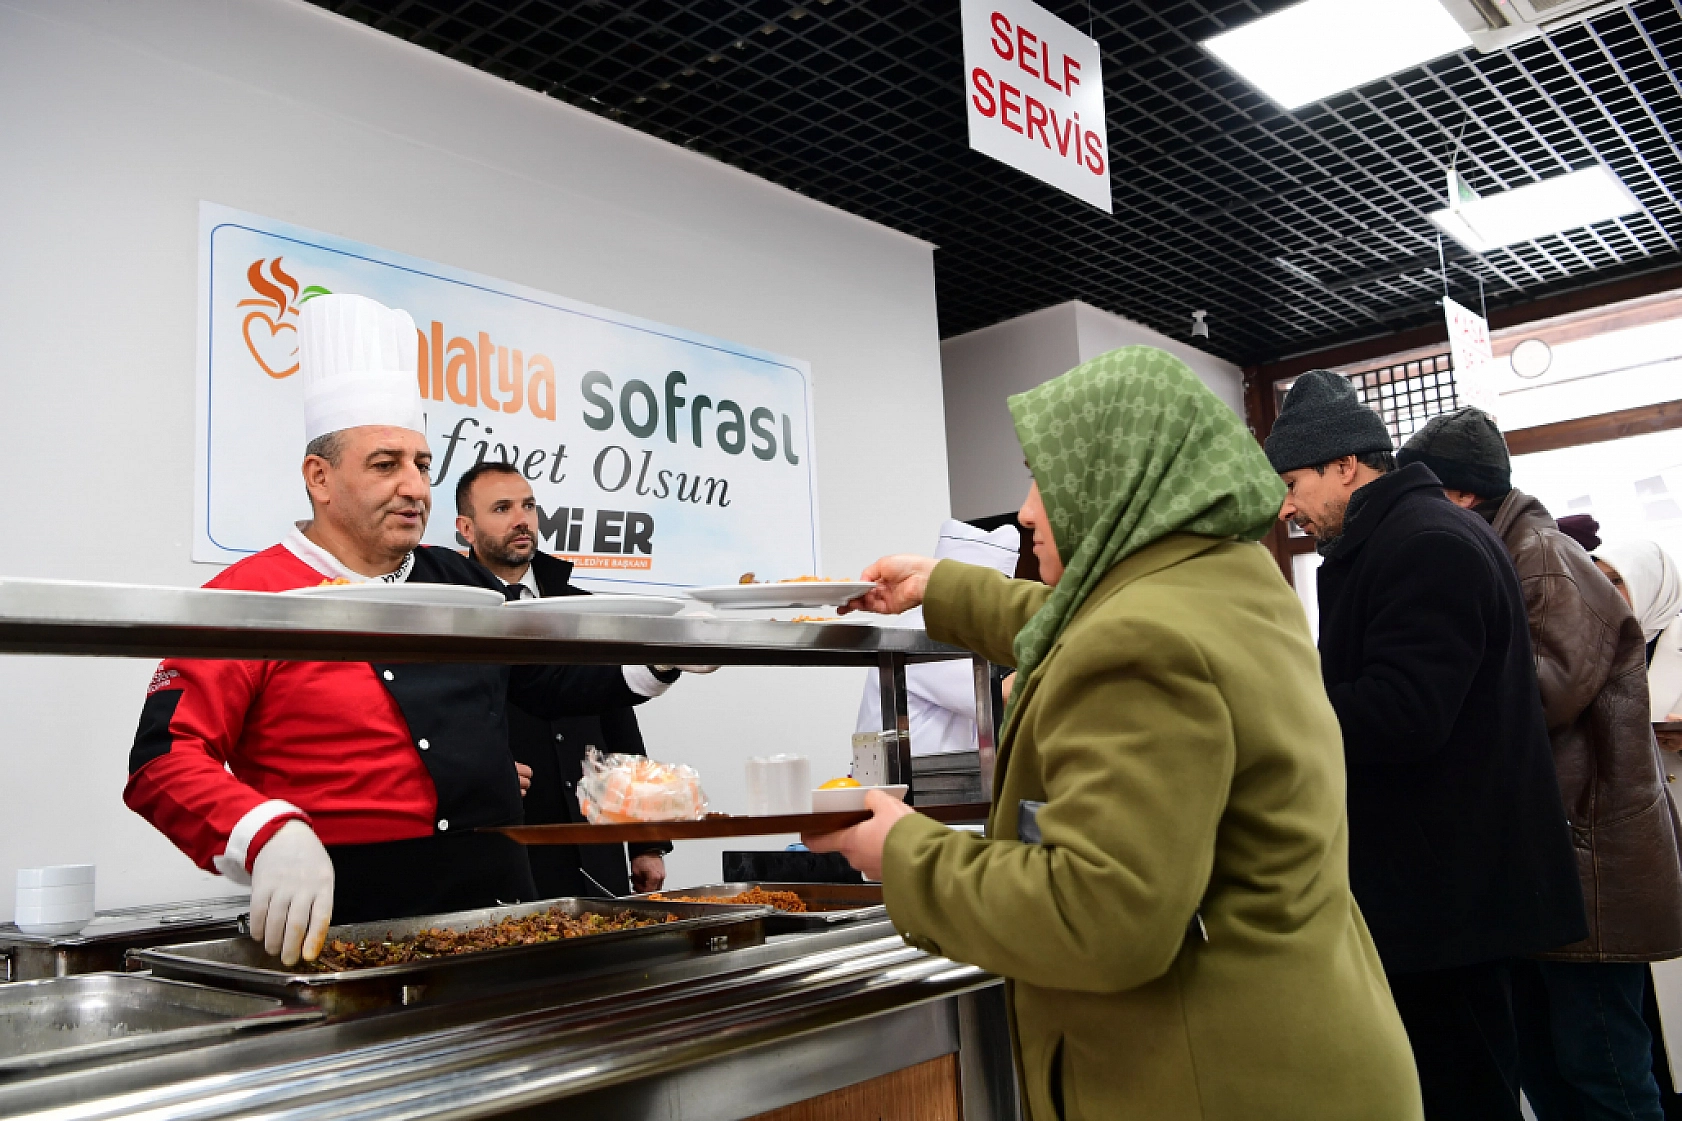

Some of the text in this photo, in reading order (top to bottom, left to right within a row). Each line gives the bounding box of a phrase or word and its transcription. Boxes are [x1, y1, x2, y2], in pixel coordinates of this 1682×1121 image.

[990, 11, 1081, 97] SELF
[972, 67, 1105, 176] SERVİS
[417, 320, 556, 421] latya
[422, 412, 731, 507] fiet Olsun
[593, 510, 654, 554] ER
